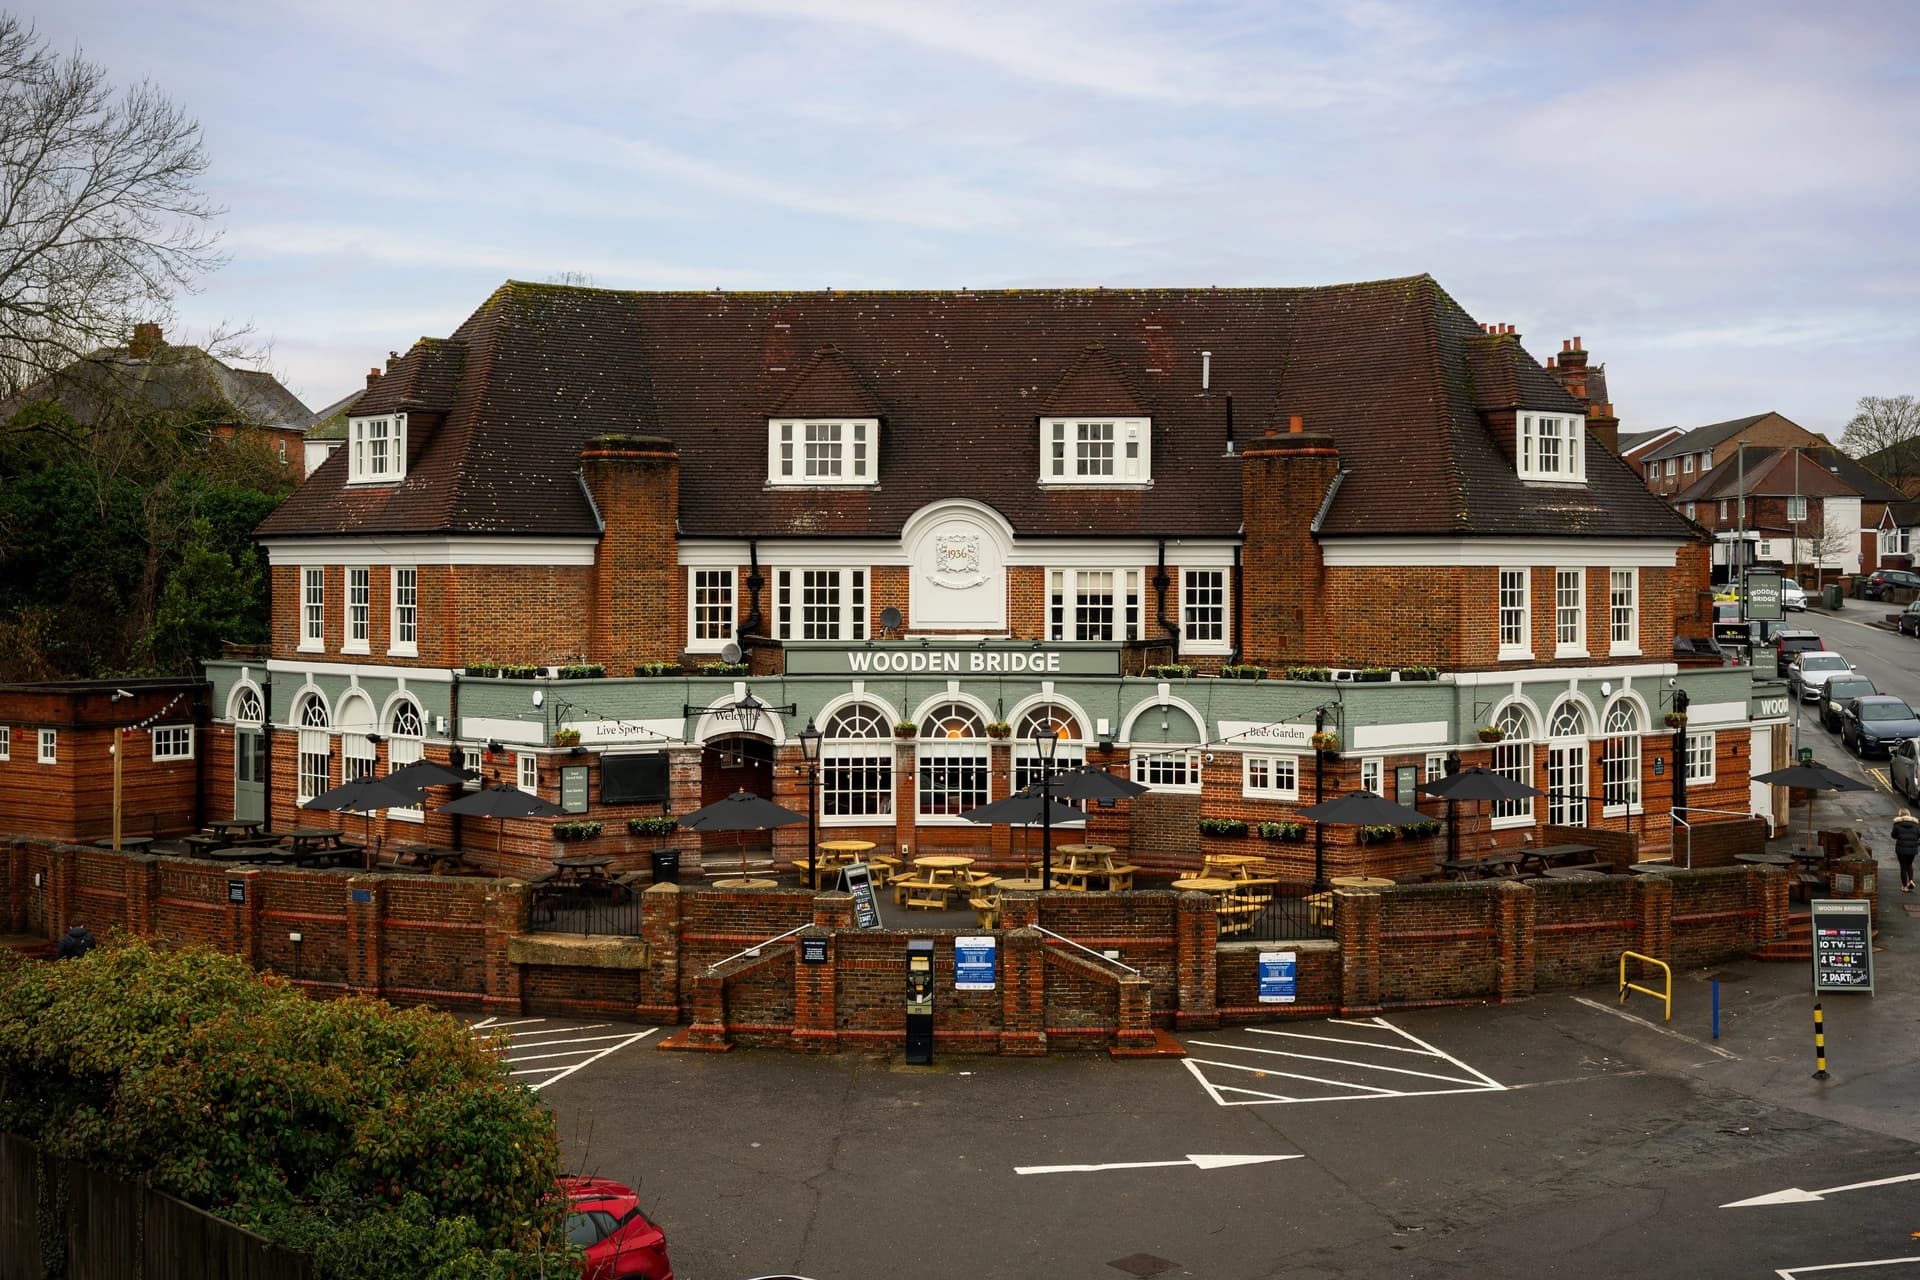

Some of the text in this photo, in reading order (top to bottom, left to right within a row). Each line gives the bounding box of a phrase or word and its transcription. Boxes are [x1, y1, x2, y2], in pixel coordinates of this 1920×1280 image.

[947, 548, 967, 560] 1936
[1750, 589, 1779, 597] WOODEN
[848, 652, 1060, 672] WOODEN BRIDGE
[716, 711, 761, 721] Welcome
[597, 725, 644, 736] Live Sport
[1250, 727, 1304, 738] Beer Garden
[1820, 941, 1829, 949] 10
[1821, 956, 1827, 964] 4
[1822, 973, 1828, 982] 2
[1830, 973, 1851, 982] DART
